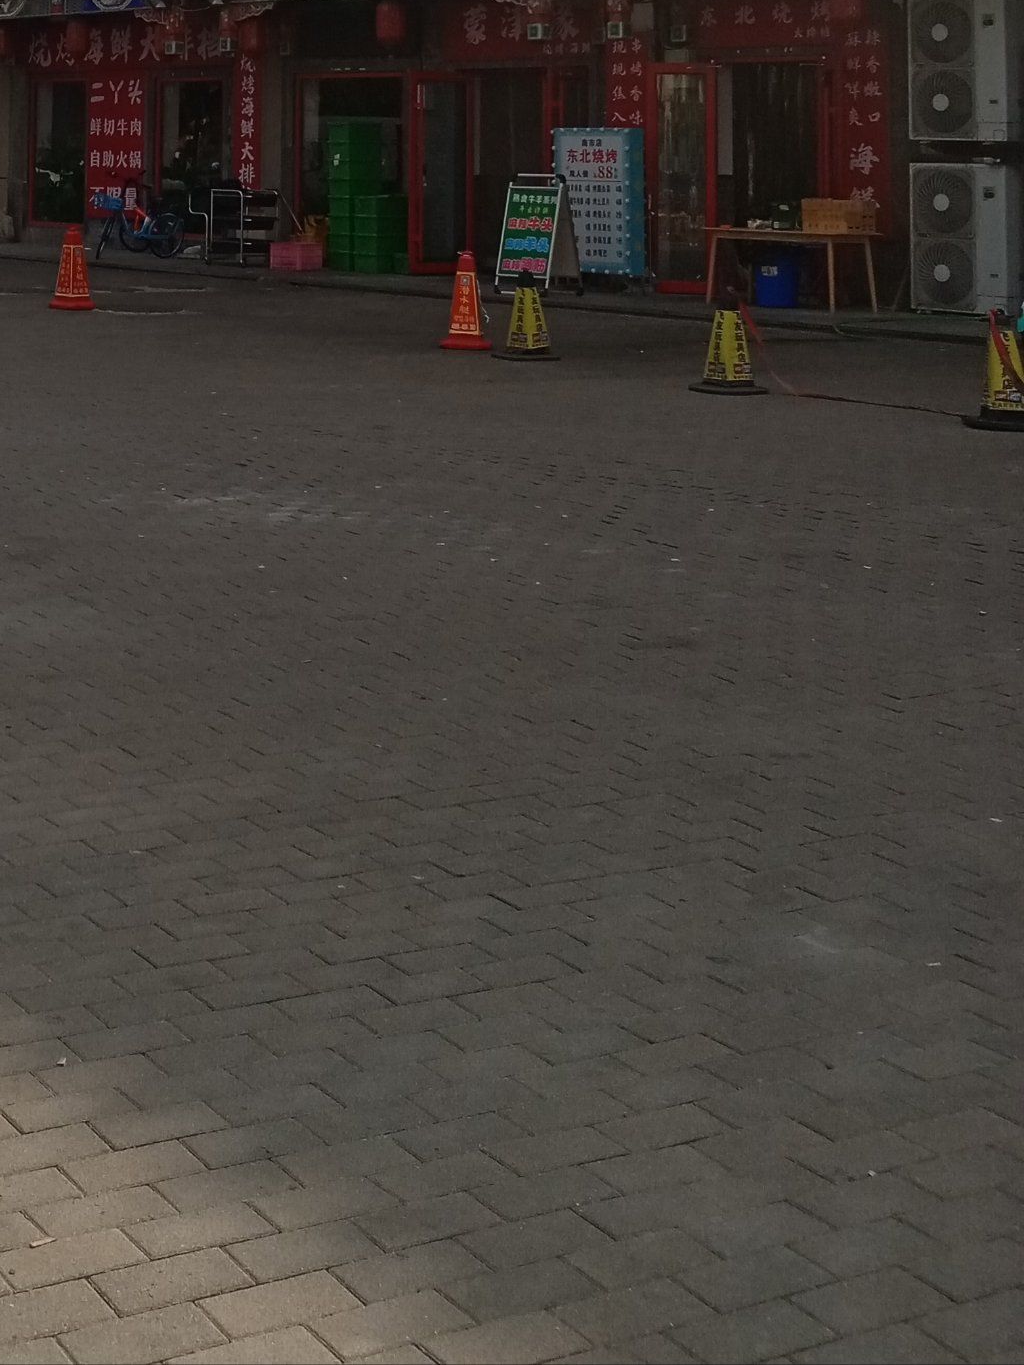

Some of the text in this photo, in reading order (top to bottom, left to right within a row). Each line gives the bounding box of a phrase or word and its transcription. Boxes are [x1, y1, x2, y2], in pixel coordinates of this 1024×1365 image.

[700, 0, 831, 27] 东北烧烤
[90, 79, 143, 106] 二丫头
[89, 118, 142, 137] 鲜切牛肉
[238, 54, 256, 190] 烧烤海鲜大排
[90, 149, 142, 169] 自助火锅
[566, 149, 618, 164] 东北烧烤
